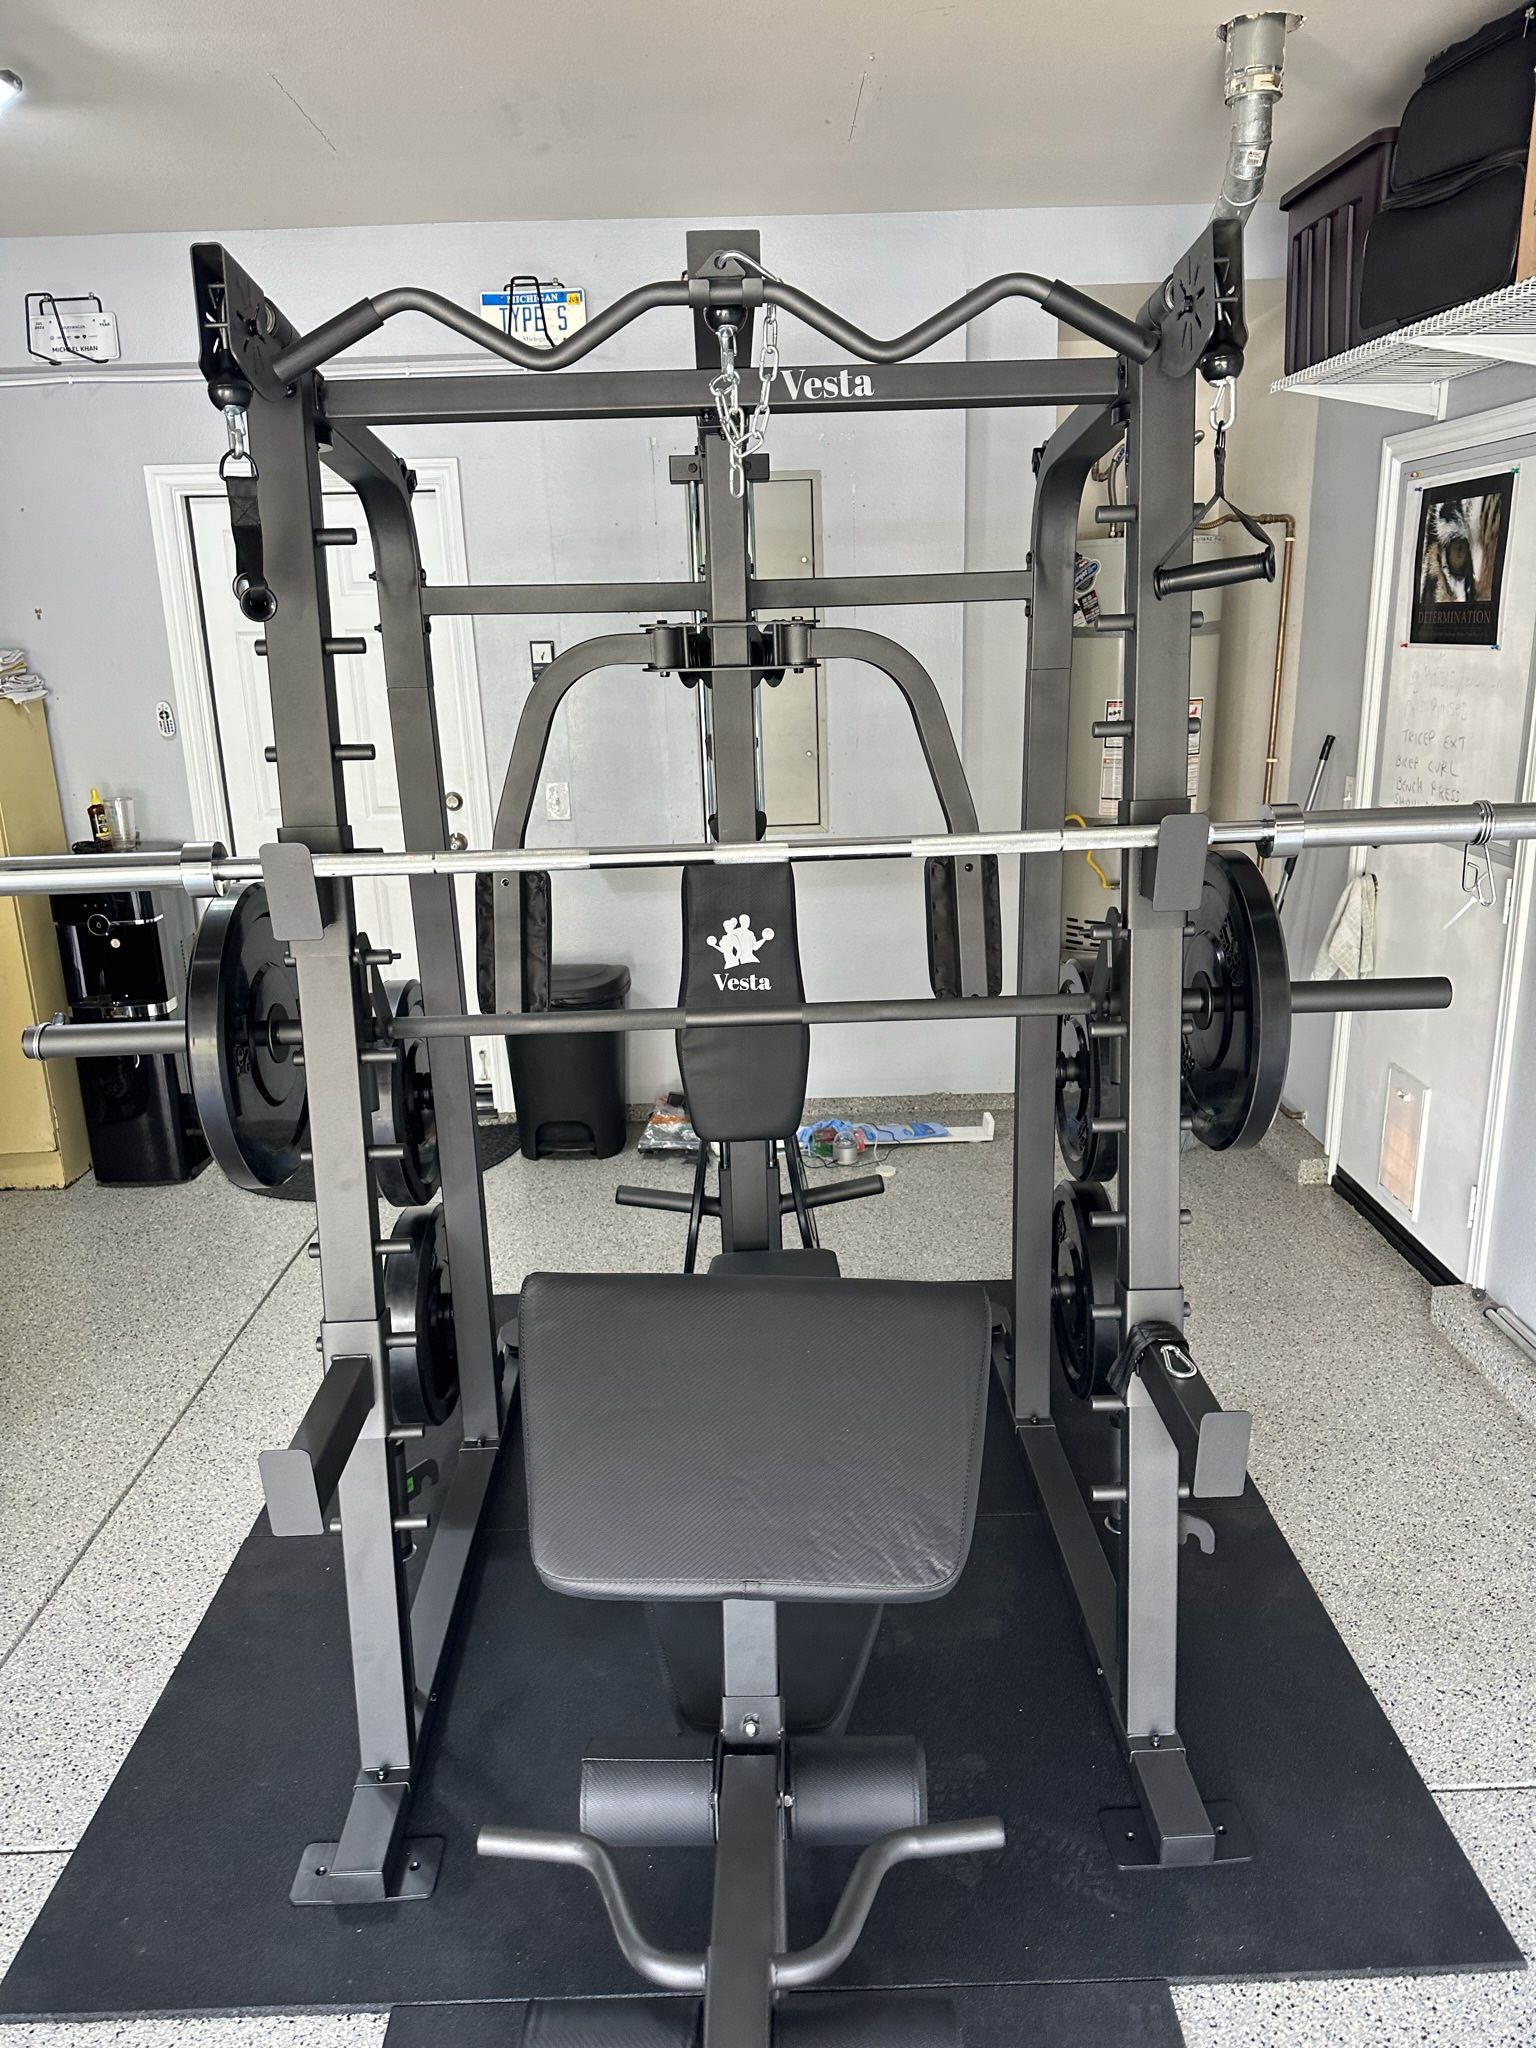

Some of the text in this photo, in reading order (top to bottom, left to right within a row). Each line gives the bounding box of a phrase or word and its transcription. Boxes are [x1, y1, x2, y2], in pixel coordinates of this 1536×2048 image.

[507, 293, 558, 304] MICHIGAN
[499, 305, 567, 332] TYPE S
[780, 369, 875, 400] Vesta
[1417, 609, 1491, 624] DETERMINATION
[1402, 729, 1466, 752] TRICEP EXT
[1428, 760, 1459, 777] CURL
[1395, 776, 1460, 803] BENCH PRESS
[713, 973, 772, 991] Vesta
